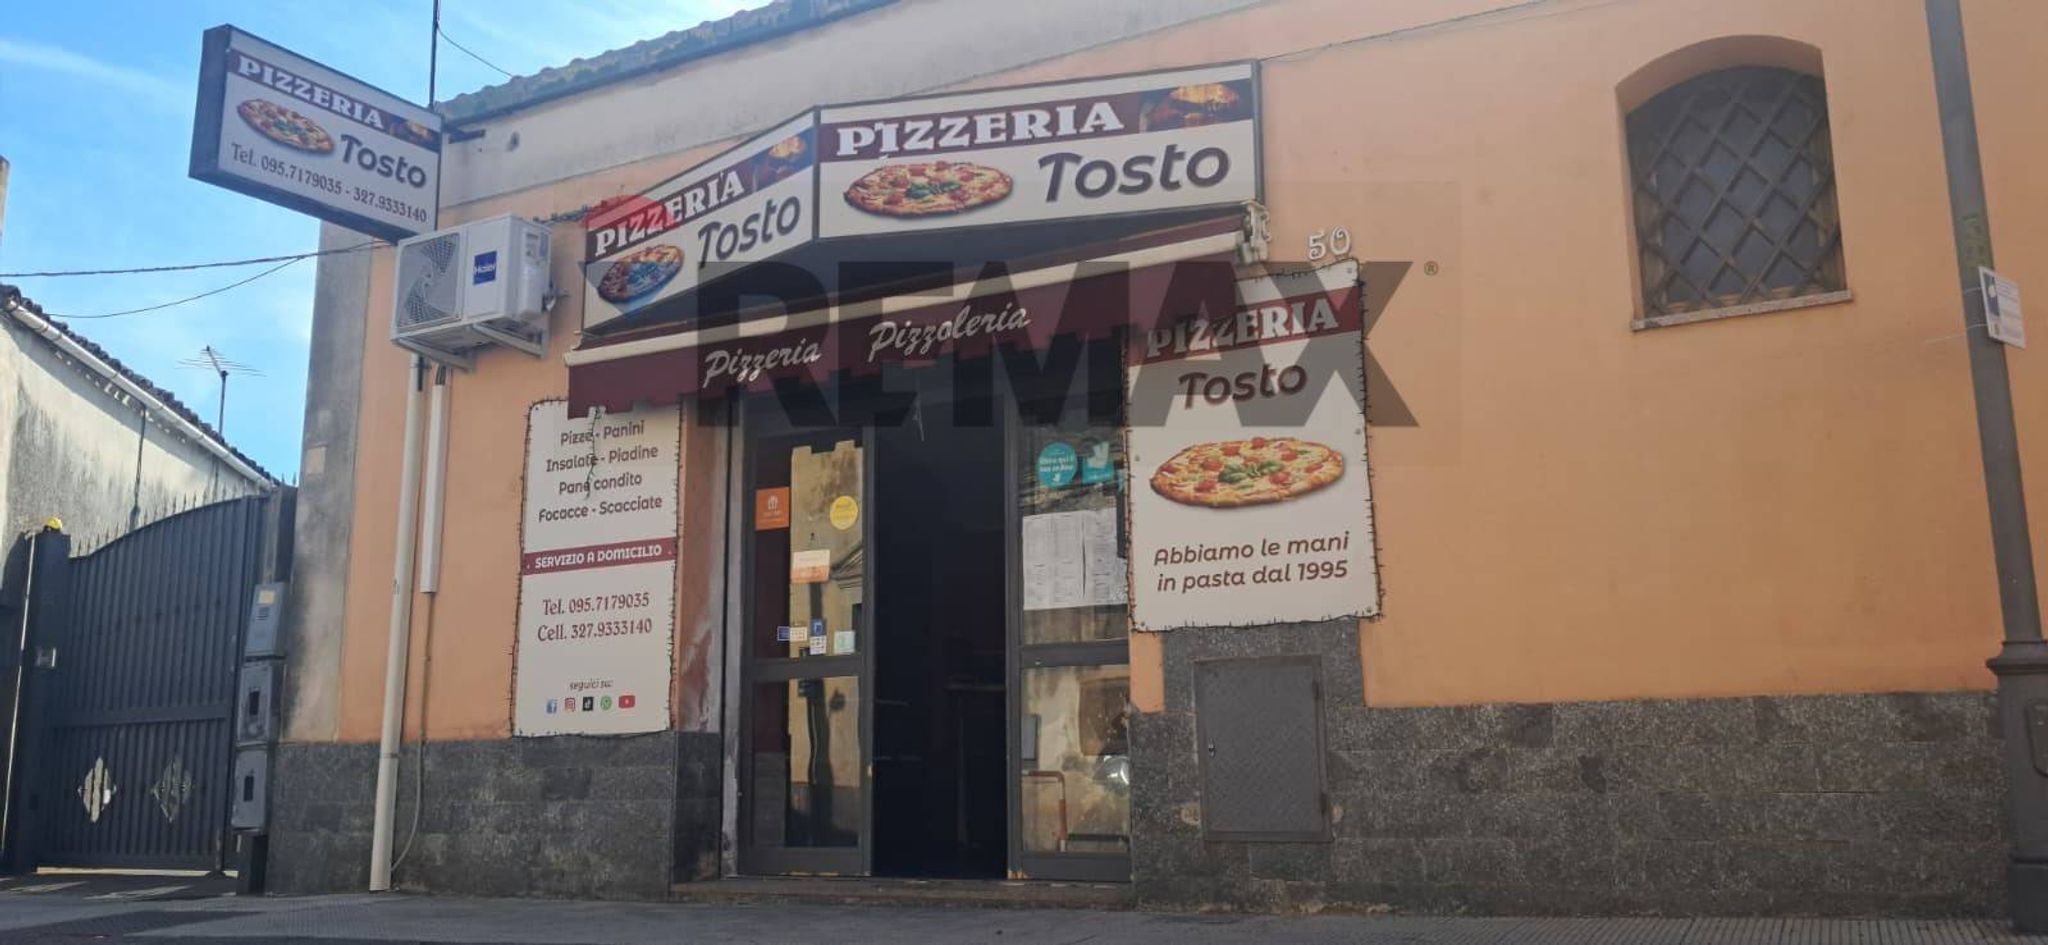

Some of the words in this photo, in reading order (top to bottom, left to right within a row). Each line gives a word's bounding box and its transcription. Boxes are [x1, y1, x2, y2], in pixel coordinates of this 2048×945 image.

[238, 55, 385, 130] PIZZERIA
[837, 101, 1124, 157] PIZZERIA
[340, 134, 427, 188] Tosto
[1038, 144, 1230, 203] Tosto
[231, 143, 257, 167] Tel.
[261, 155, 342, 195] 095.7179035
[353, 187, 427, 223] 327.9333140
[594, 171, 745, 256] PIZZERIA
[698, 196, 801, 269] Tosto
[1308, 227, 1351, 261] 50
[702, 338, 821, 388] Pizzeria
[867, 302, 1031, 362] Pizzoleria
[1147, 298, 1339, 358] PIZZERIA
[1179, 363, 1308, 410] Tosto
[561, 431, 593, 446] Pizze
[603, 420, 645, 439] Panini
[546, 452, 598, 472] Insalate
[609, 445, 659, 463] Piadine
[559, 480, 591, 494] Pane
[593, 472, 642, 491] condito
[538, 505, 589, 522] Focacce
[599, 496, 663, 515] Scacciate
[535, 553, 585, 569] SERVIZIO
[587, 552, 596, 563] A
[597, 544, 662, 562] DOMICILIO
[1154, 544, 1254, 566] Abbiamo
[1261, 538, 1280, 556] le
[1287, 531, 1350, 554] mani
[1157, 574, 1176, 592] in
[1182, 570, 1246, 593] pasta
[1252, 566, 1291, 584] dal
[1298, 560, 1349, 582] 1995
[543, 599, 565, 615] Tel.
[569, 592, 650, 614] 095.7179035
[538, 624, 567, 642] Cell.
[571, 618, 653, 640] 327.9333140
